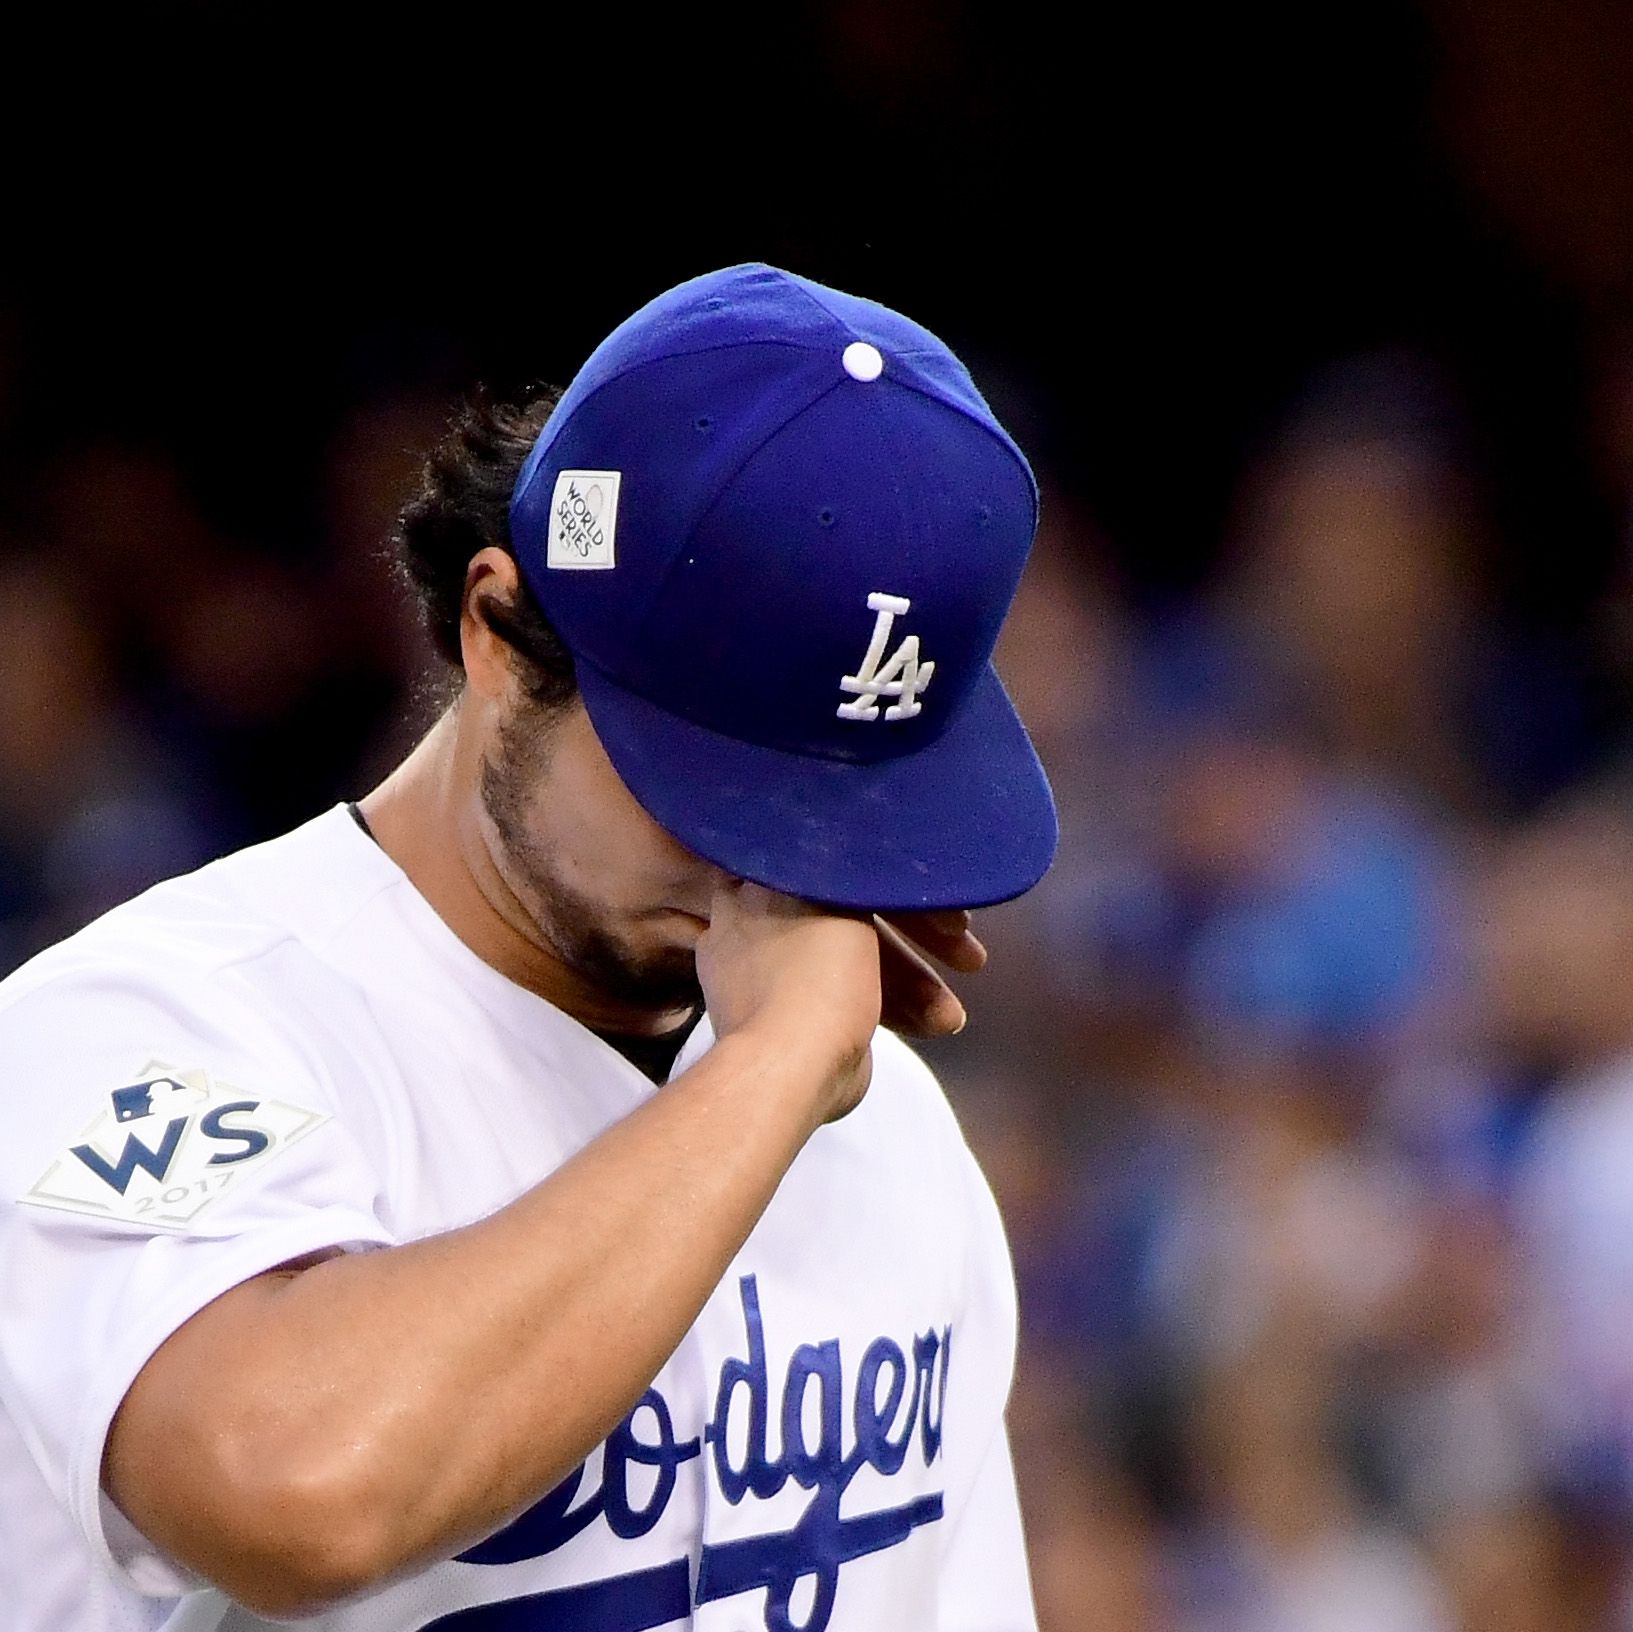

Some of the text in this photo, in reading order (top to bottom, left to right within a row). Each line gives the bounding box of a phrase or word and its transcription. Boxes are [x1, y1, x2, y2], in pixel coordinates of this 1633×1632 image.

[556, 500, 593, 557] SERIES
[568, 480, 604, 546] WORLD
[837, 592, 935, 721] LA
[69, 1101, 271, 1196] WS
[135, 1170, 236, 1213] 2017
